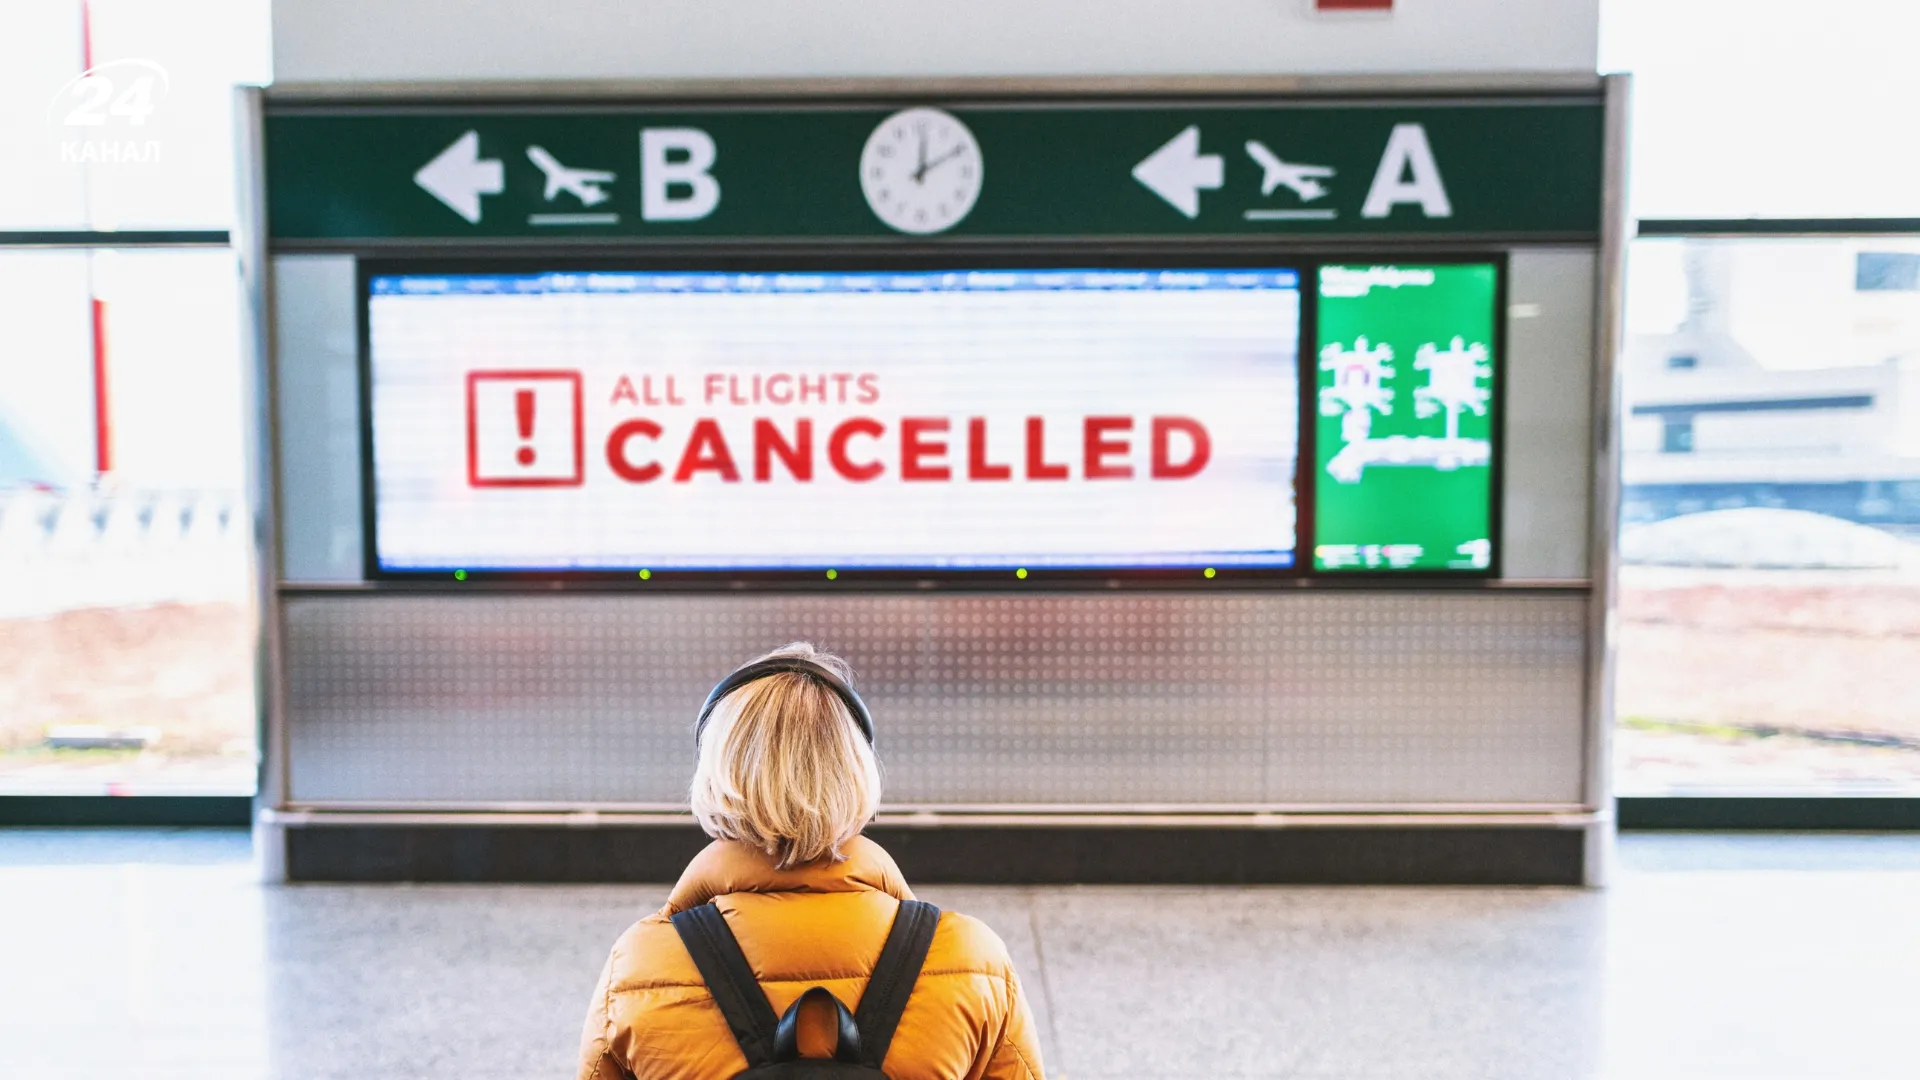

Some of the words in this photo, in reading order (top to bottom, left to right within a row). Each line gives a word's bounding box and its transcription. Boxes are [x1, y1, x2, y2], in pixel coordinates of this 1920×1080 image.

[639, 128, 720, 221] B
[1361, 123, 1452, 219] A
[609, 373, 686, 406] ALL
[704, 373, 881, 406] FLIGHTS
[604, 415, 1213, 484] CANCELLED
